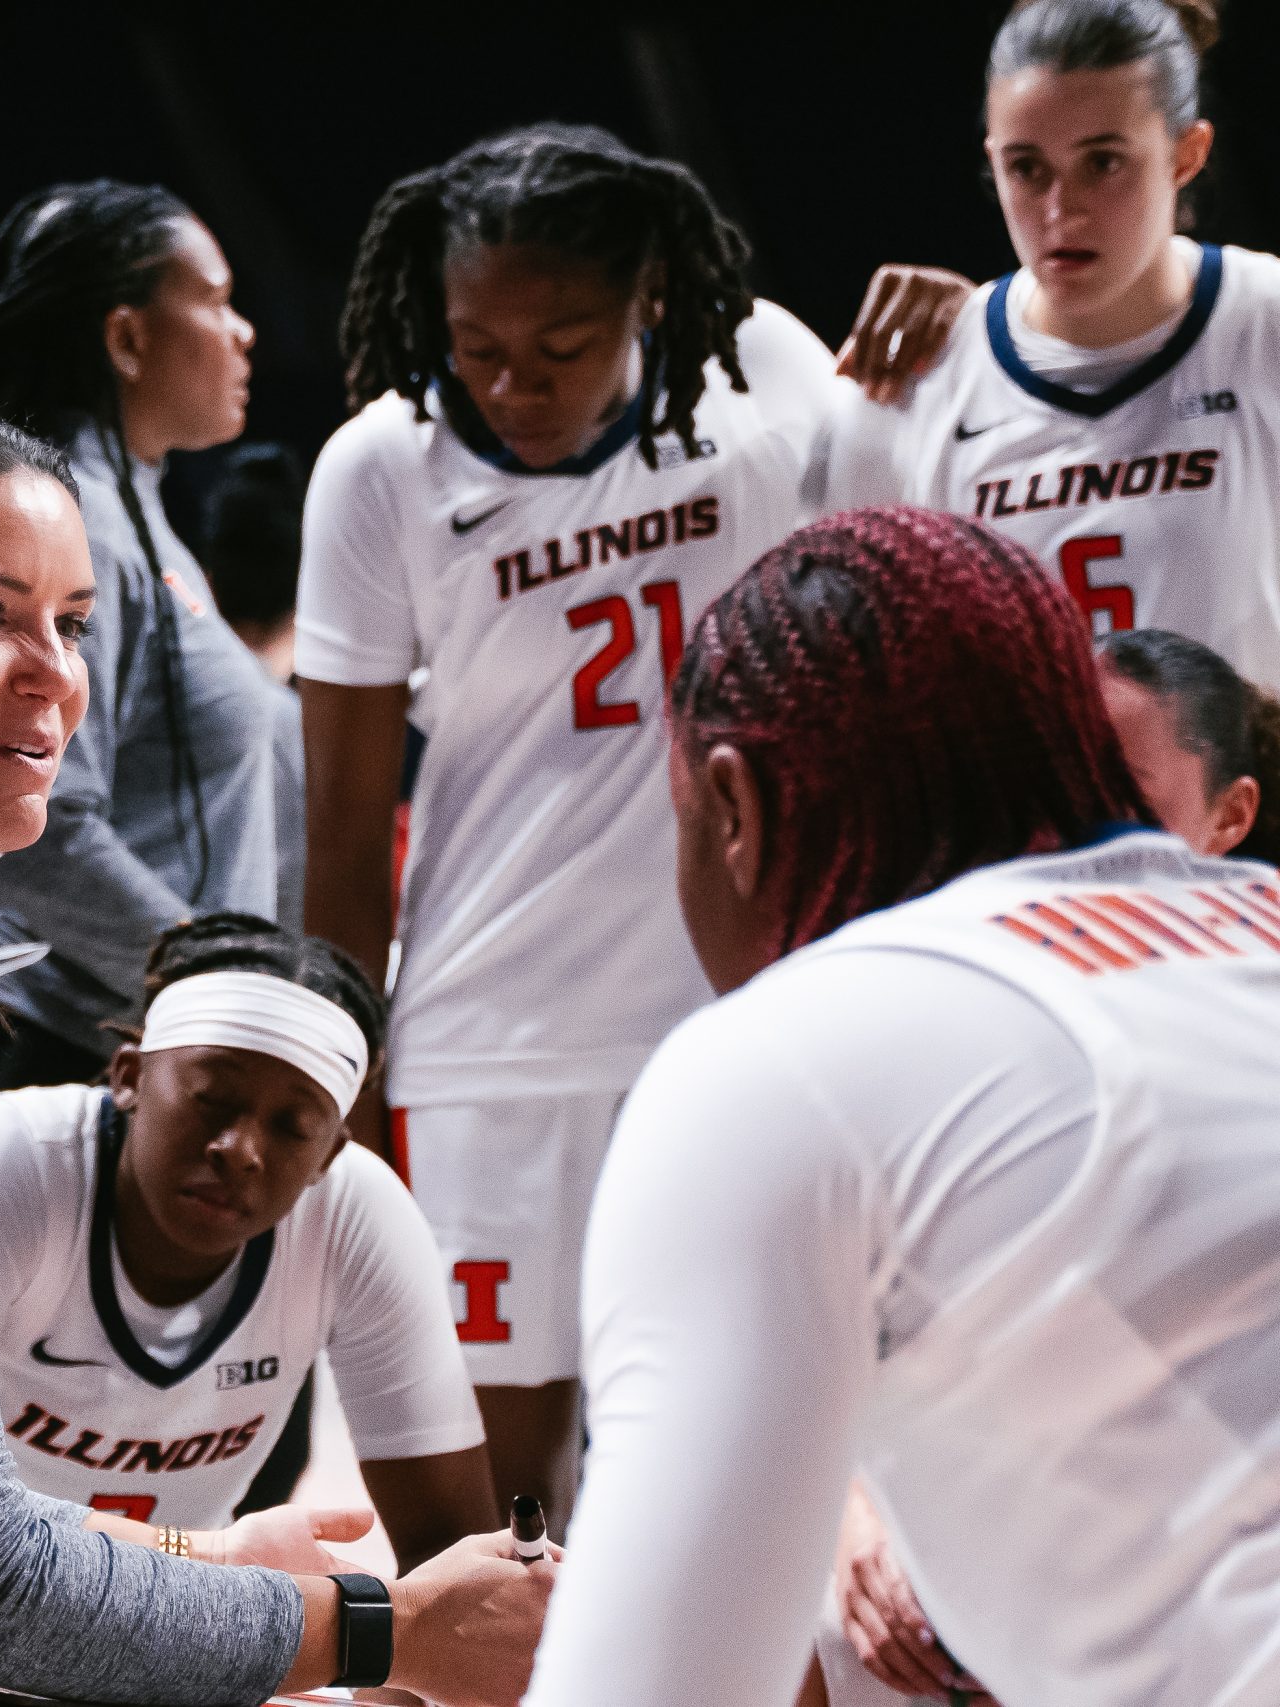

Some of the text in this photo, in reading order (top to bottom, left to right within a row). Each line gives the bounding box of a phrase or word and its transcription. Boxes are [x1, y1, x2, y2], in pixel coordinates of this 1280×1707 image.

[975, 449, 1219, 518] ILLINOIS
[493, 497, 718, 600] ILLINOIS
[566, 579, 685, 730] 21
[453, 1260, 510, 1344] I
[6, 1402, 266, 1474] ILLINOIS
